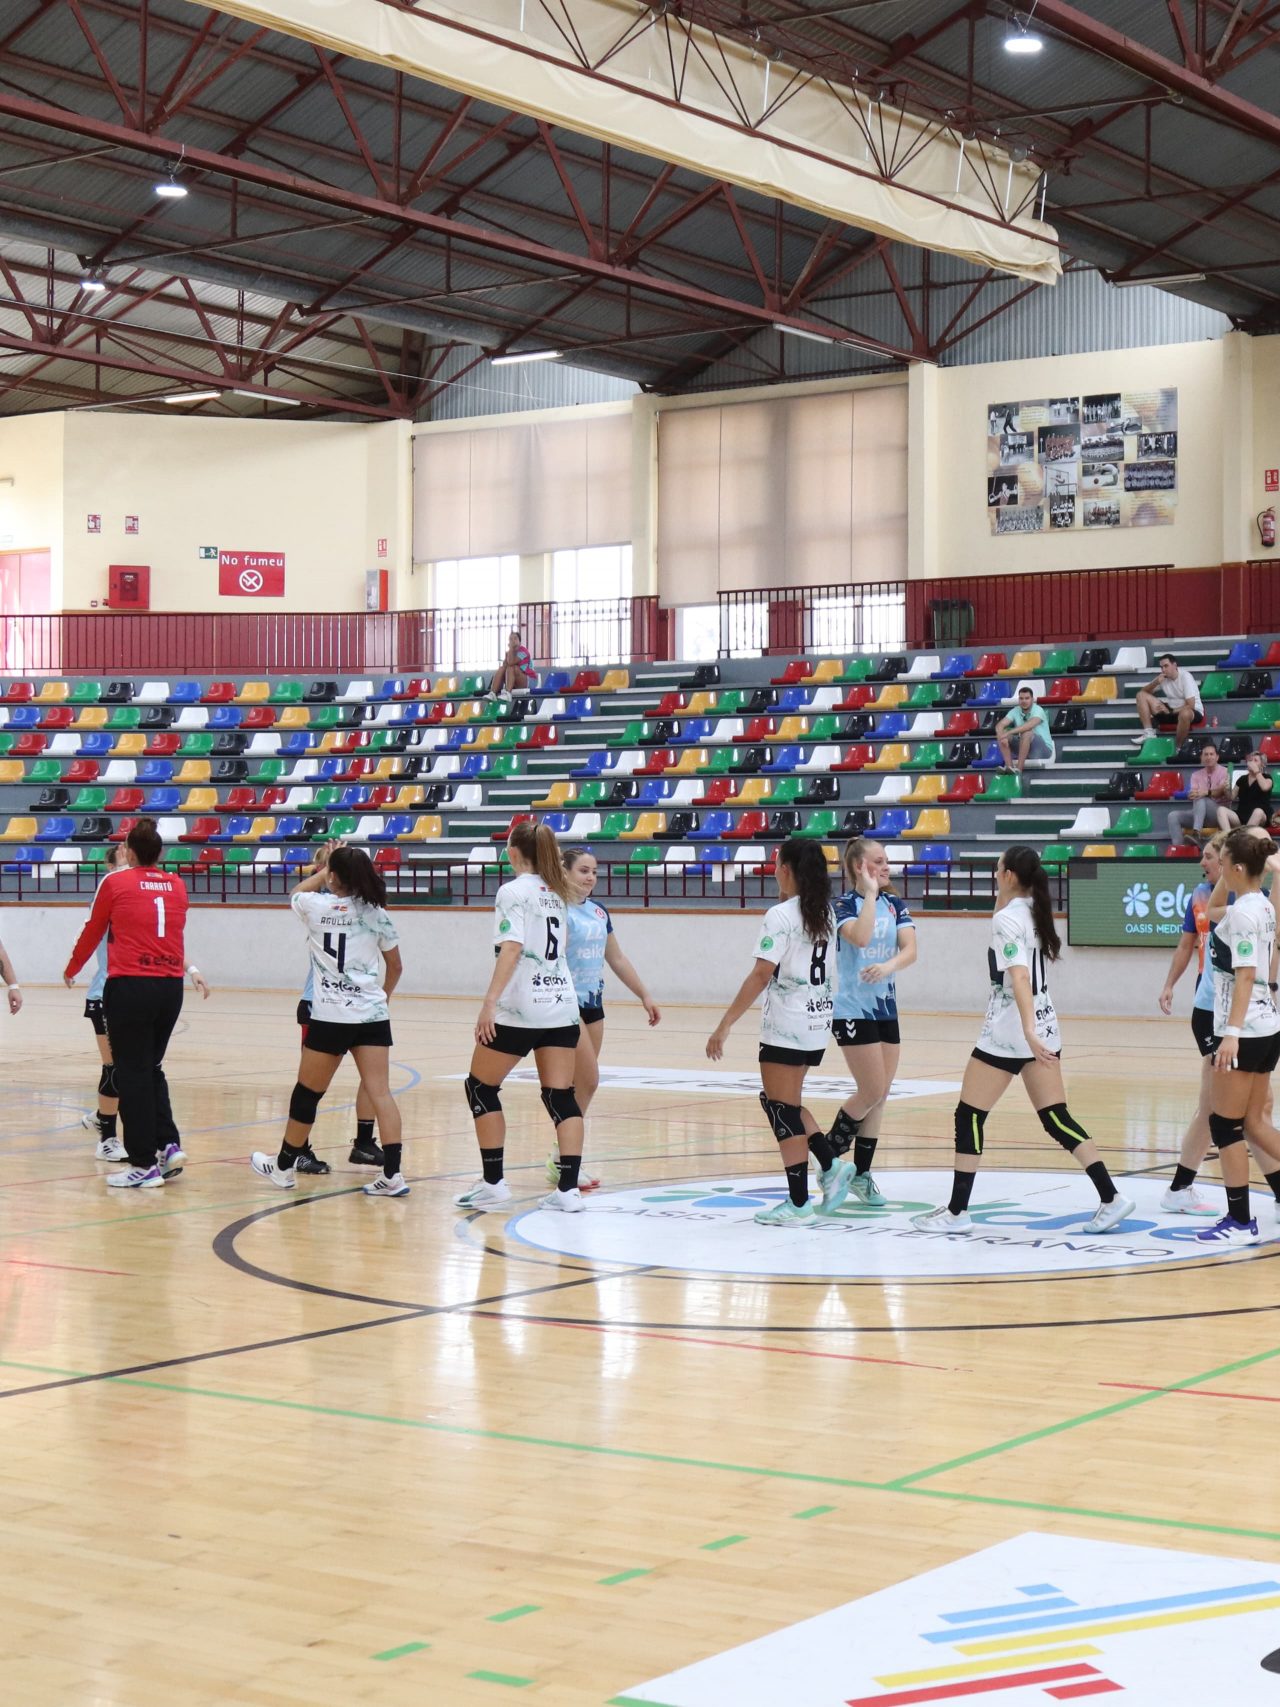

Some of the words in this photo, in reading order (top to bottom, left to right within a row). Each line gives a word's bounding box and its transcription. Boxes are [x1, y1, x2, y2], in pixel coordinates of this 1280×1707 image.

[221, 555, 238, 565] No
[244, 555, 283, 566] fumeu
[154, 896, 166, 937] 1
[1125, 923, 1153, 933] OASIS
[323, 932, 346, 974] 4
[545, 916, 559, 961] 6
[810, 939, 828, 986] 8
[584, 1205, 727, 1222] OASIS
